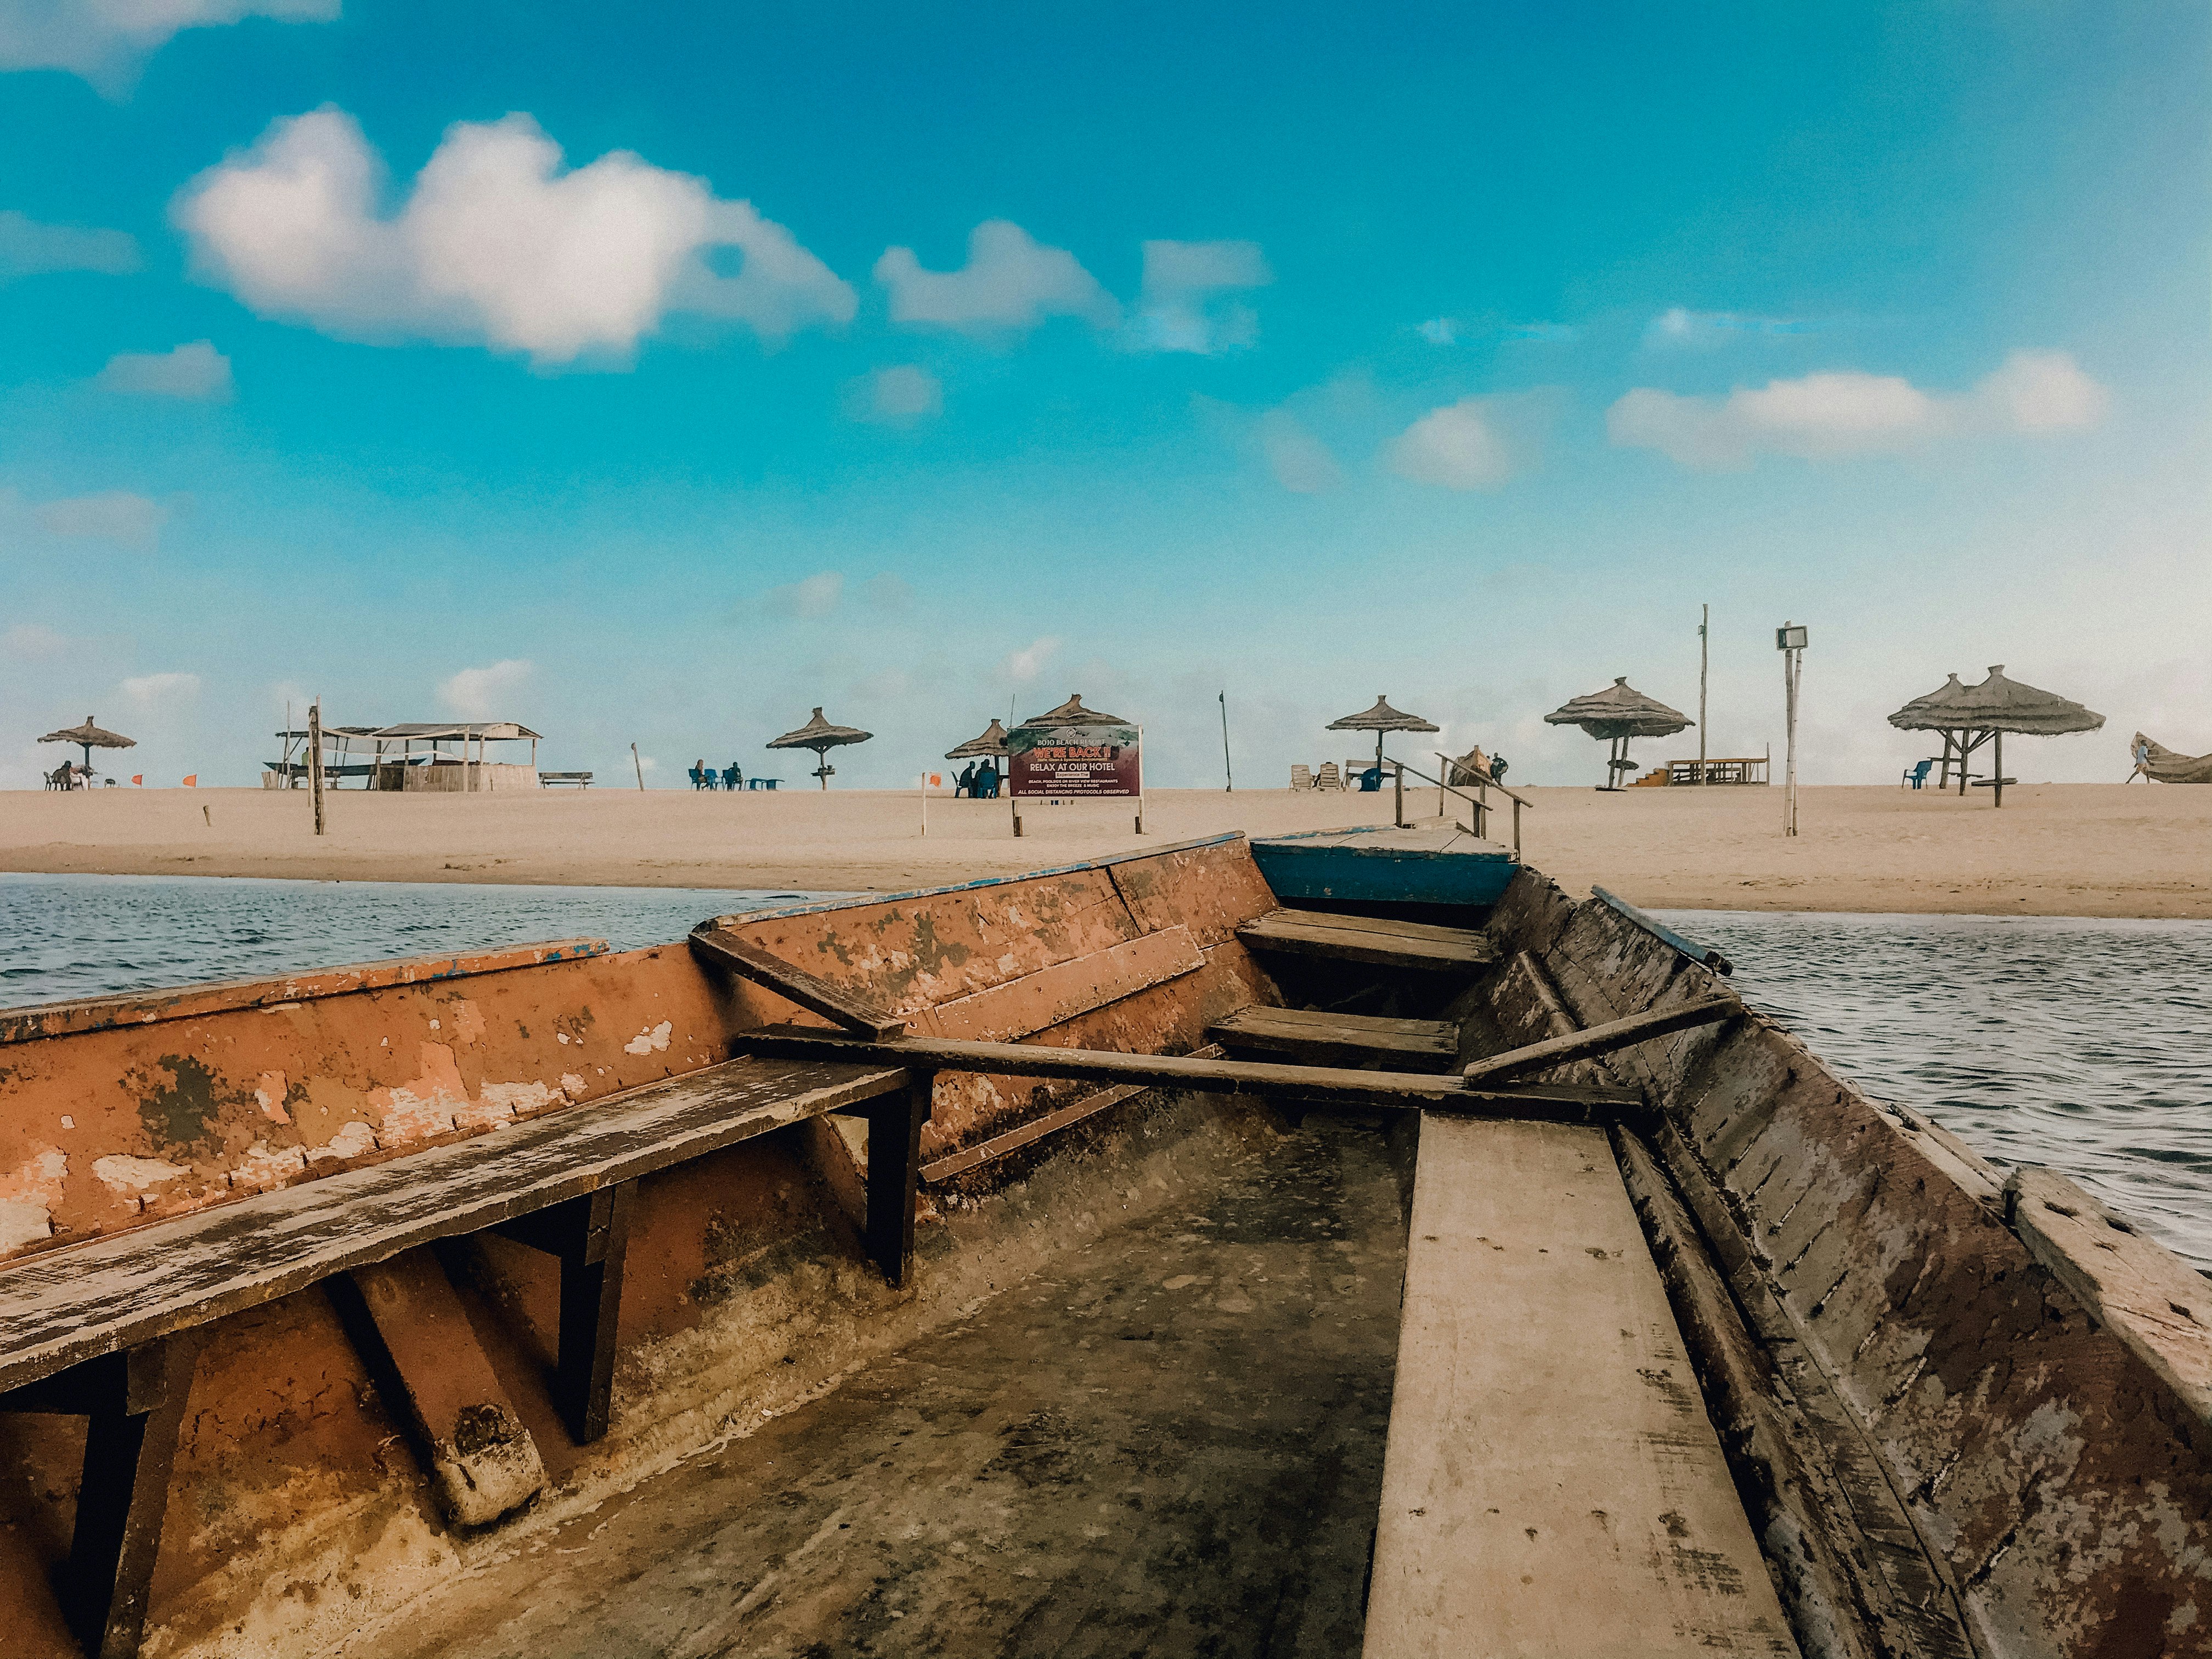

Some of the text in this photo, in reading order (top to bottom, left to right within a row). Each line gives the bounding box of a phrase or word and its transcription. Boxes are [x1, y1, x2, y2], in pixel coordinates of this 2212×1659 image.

[1034, 747, 1066, 758] WE'RE
[1069, 746, 1102, 758] BACK
[1030, 763, 1056, 771] RELAX
[1069, 763, 1087, 771] OUR
[1089, 763, 1115, 771] HOTEL
